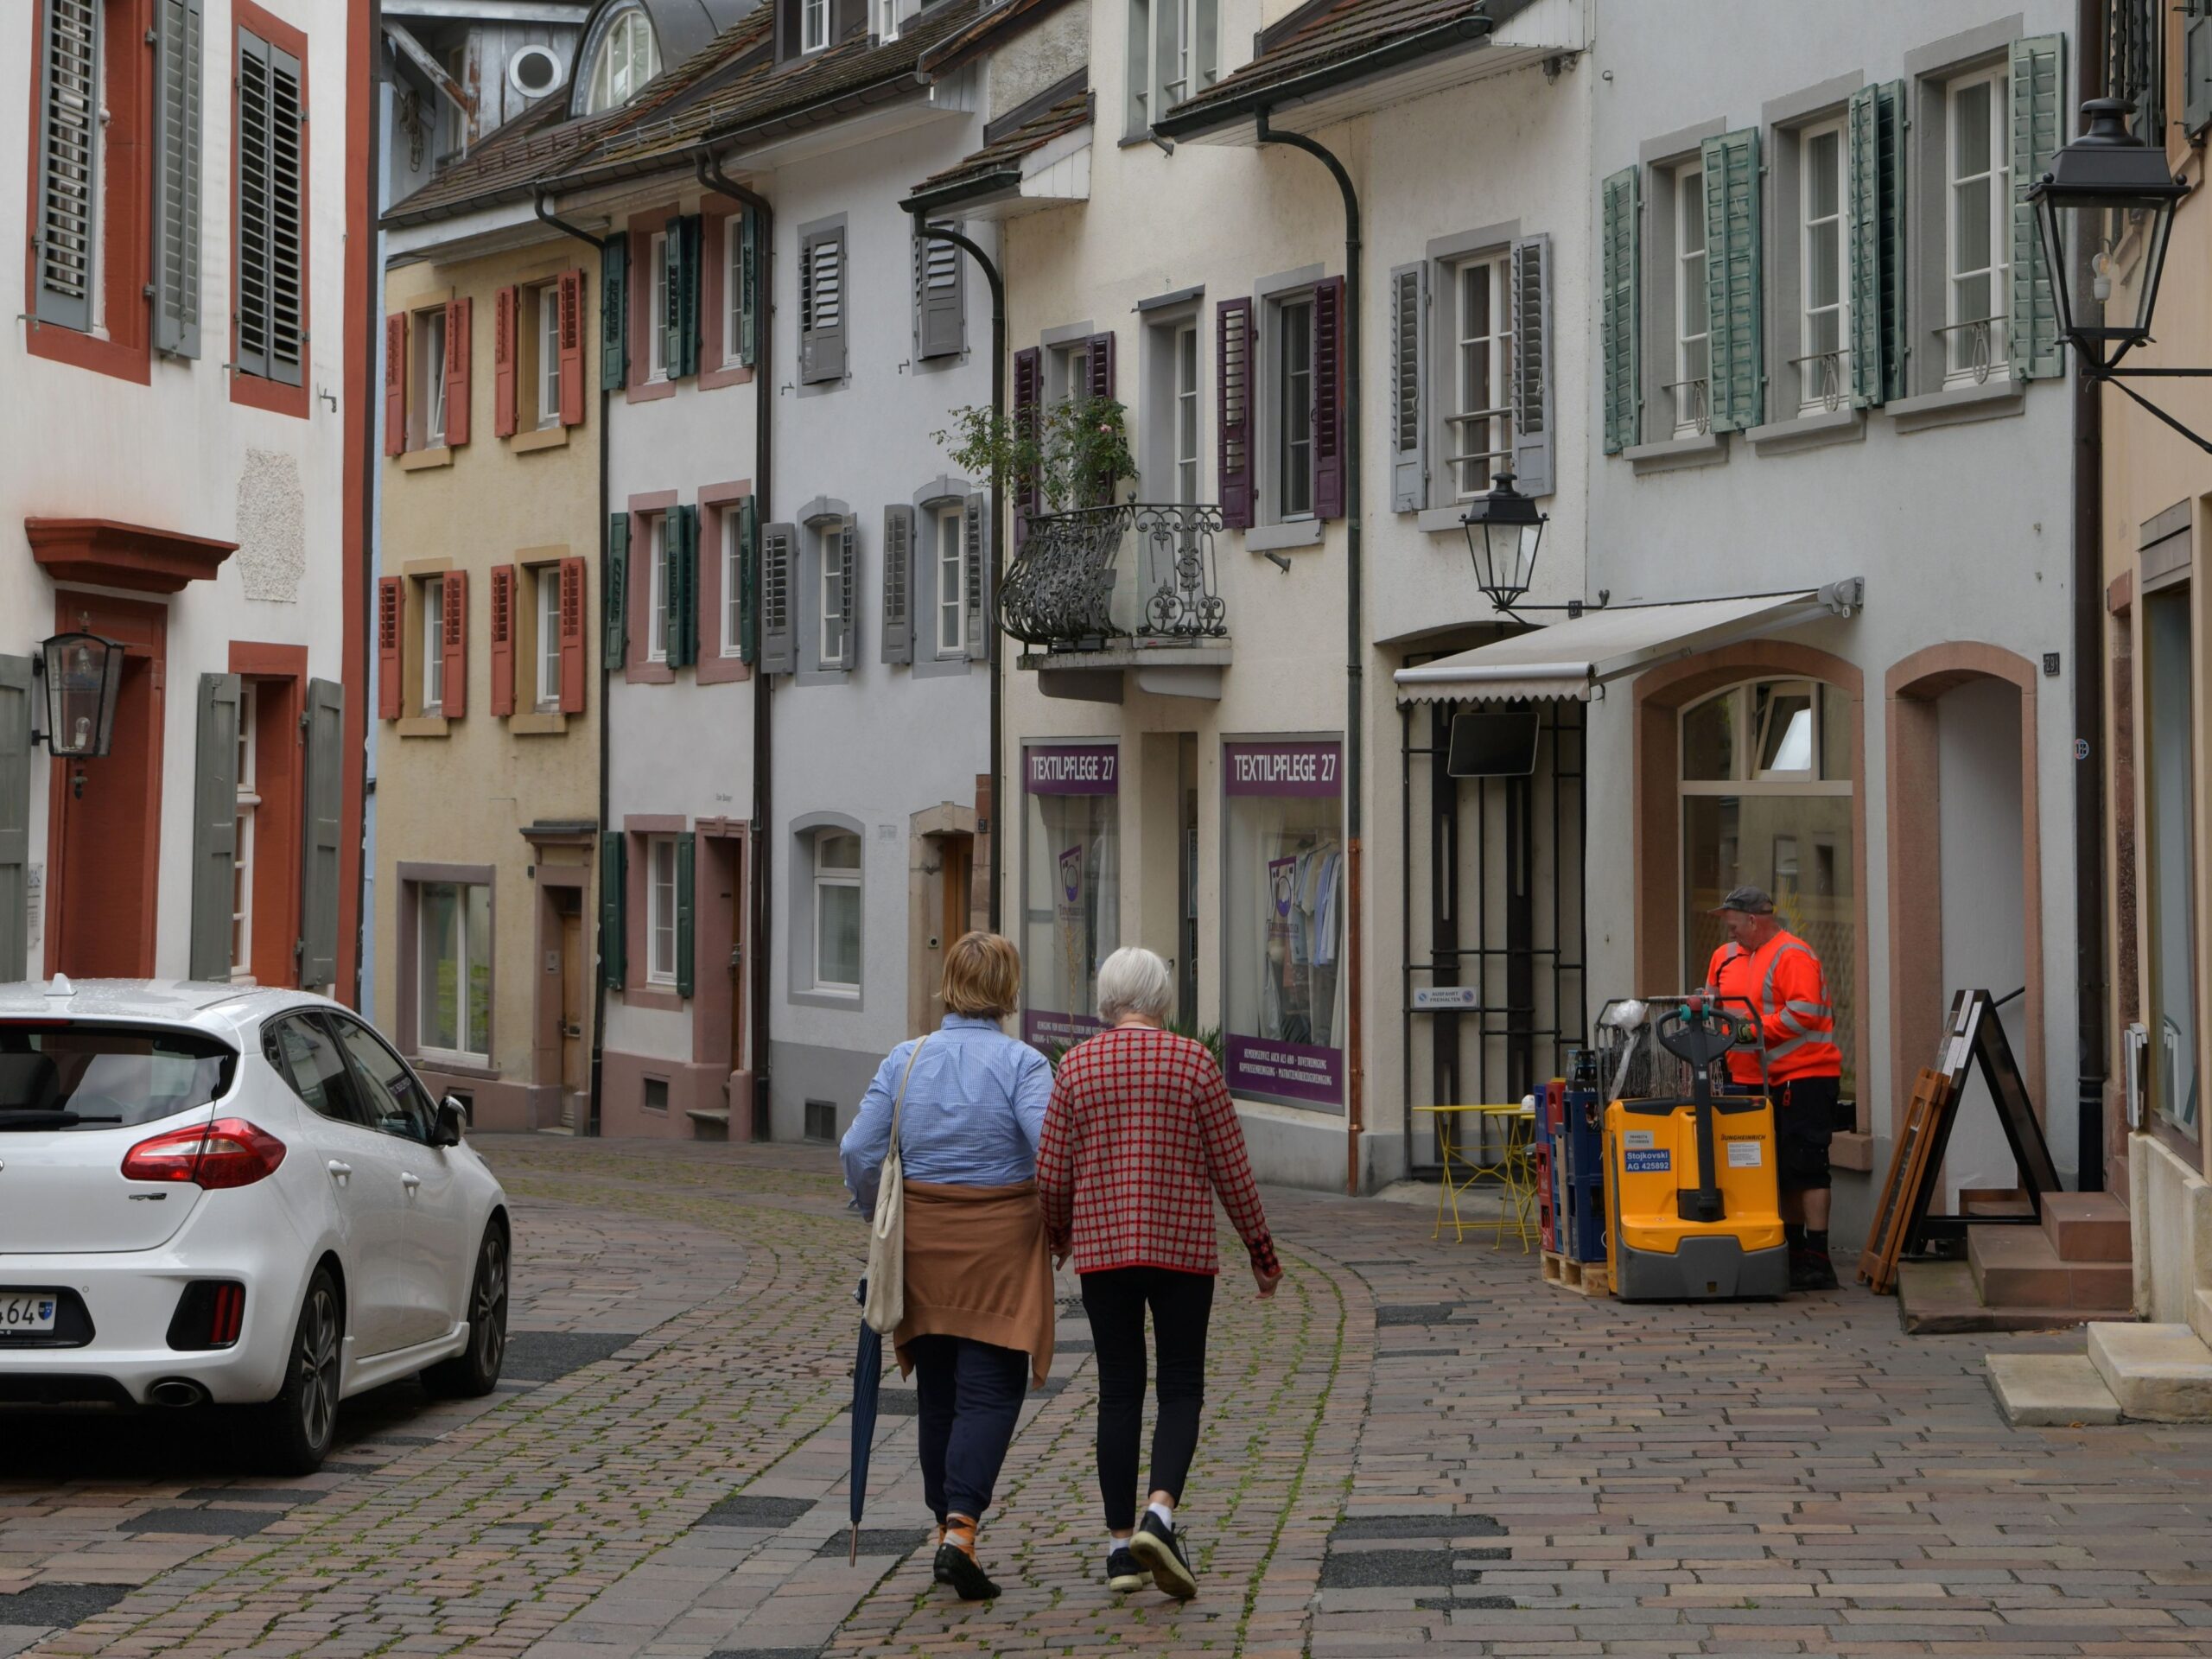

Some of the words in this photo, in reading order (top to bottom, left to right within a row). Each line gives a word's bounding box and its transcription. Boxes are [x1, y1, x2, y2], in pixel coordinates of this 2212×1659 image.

[1032, 756, 1098, 780] TEXTILPFLEGE
[1103, 755, 1115, 780] 27
[1234, 754, 1316, 781] TEXTILPFLEGE
[1321, 753, 1336, 781] 27
[1627, 1152, 1668, 1161] Stojkovski
